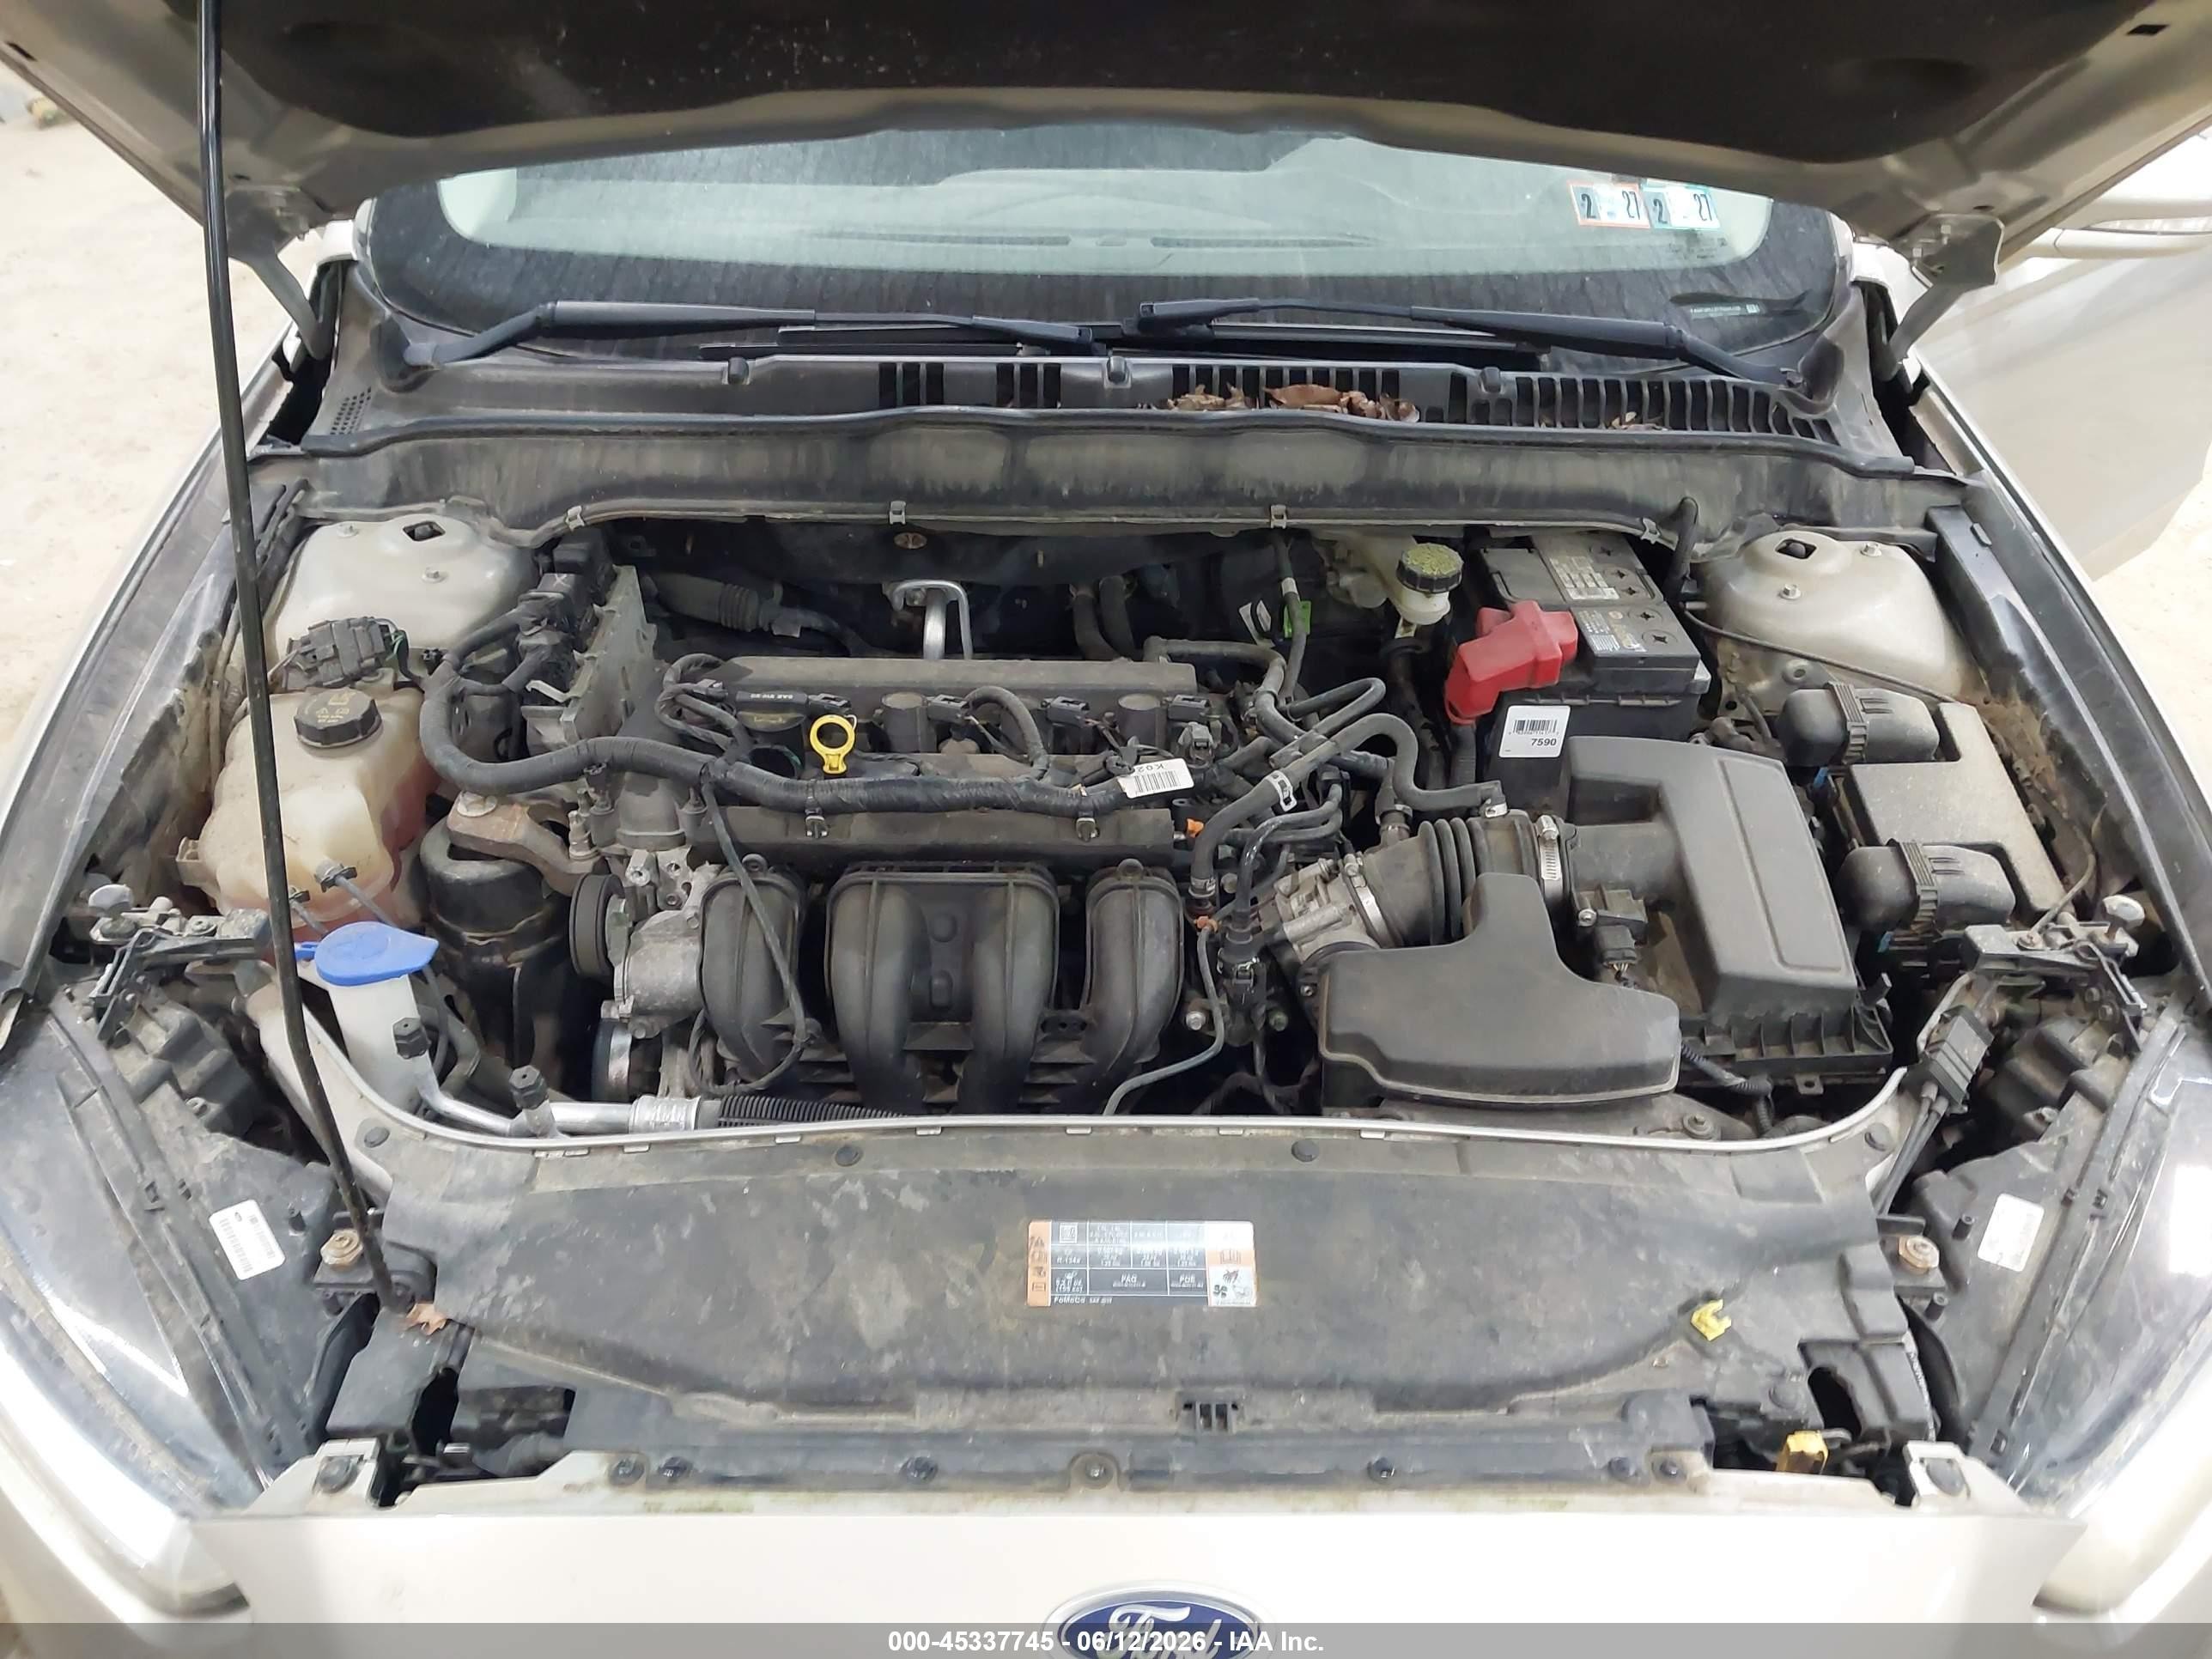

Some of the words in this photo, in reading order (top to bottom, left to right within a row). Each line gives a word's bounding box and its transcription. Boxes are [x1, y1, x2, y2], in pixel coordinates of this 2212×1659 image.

[1581, 193, 1597, 219] 2
[1622, 190, 1641, 221] 27
[1653, 198, 1668, 224] 2
[1693, 193, 1713, 222] 27
[1531, 738, 1557, 746] 7590
